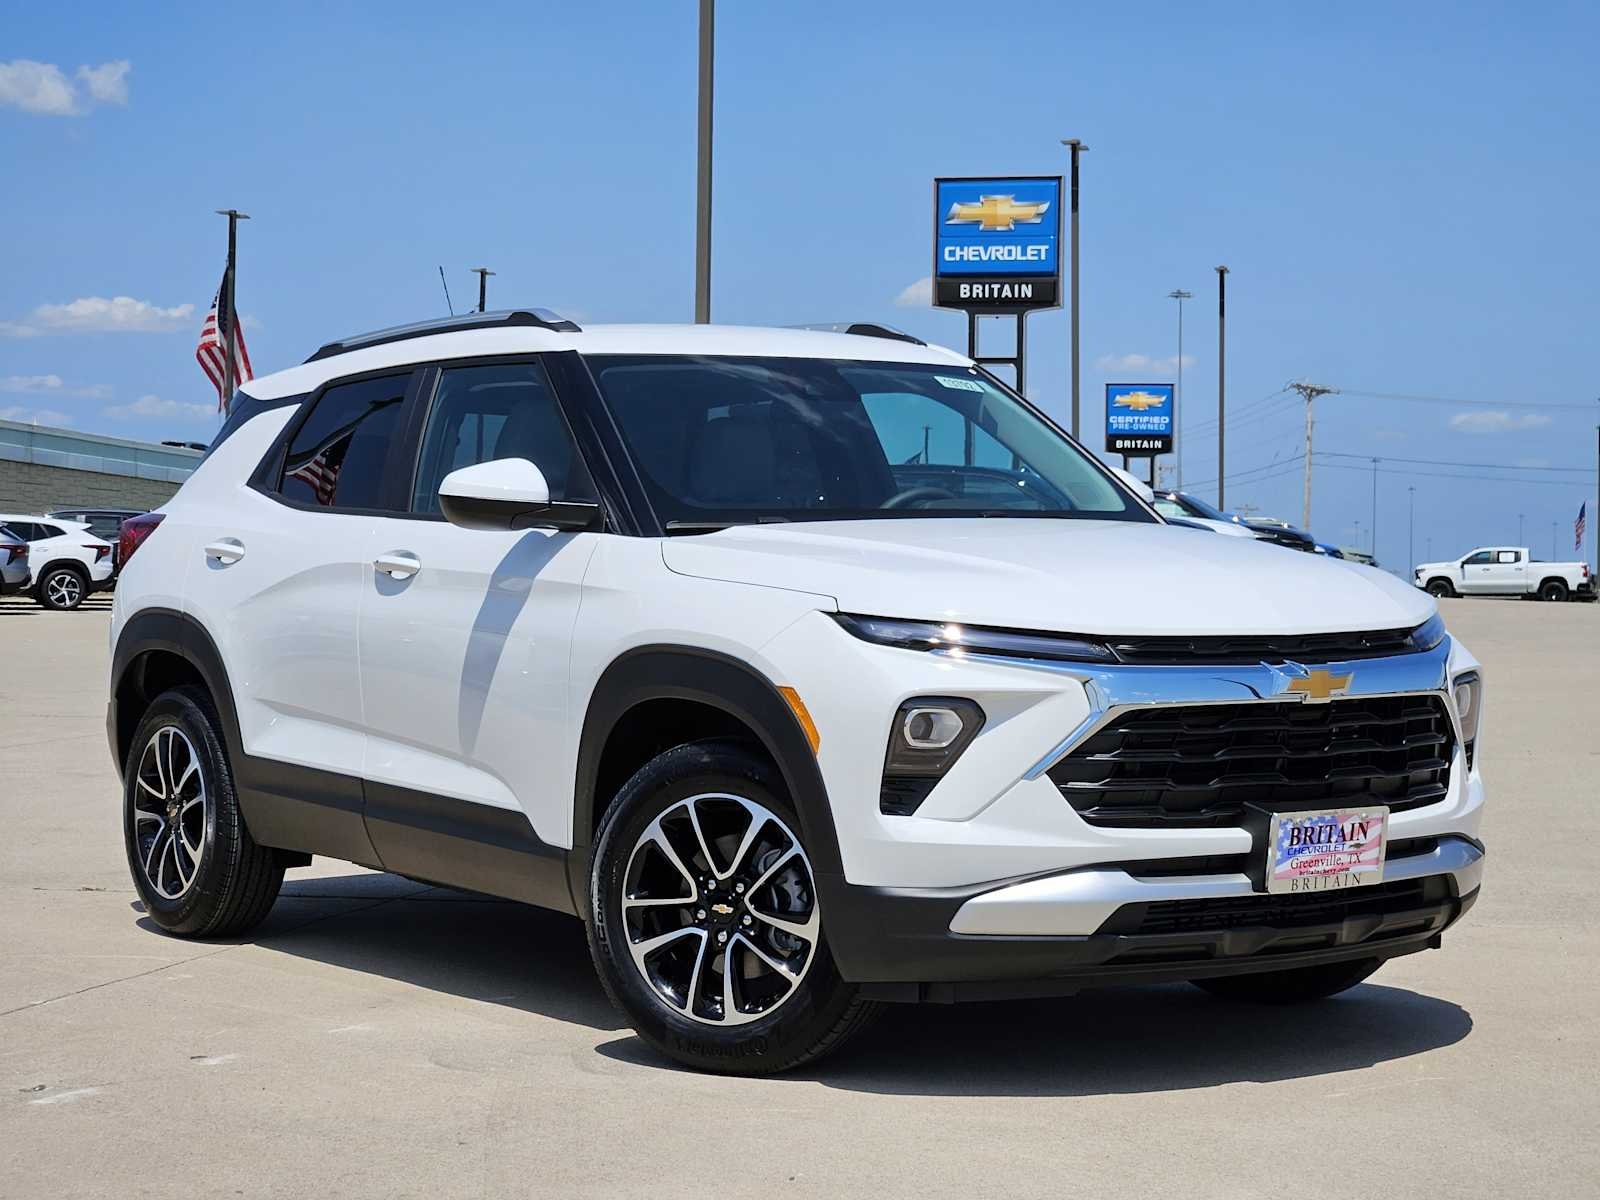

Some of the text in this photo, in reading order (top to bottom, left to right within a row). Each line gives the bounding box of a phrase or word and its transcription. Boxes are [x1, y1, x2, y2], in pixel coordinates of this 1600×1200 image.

[944, 245, 1049, 261] CHEVROLET
[959, 283, 1033, 299] BRITAIN
[1109, 416, 1169, 424] CERTIFIED
[1116, 440, 1162, 448] BRITAIN
[1290, 822, 1370, 845] BRITAIN
[1288, 844, 1346, 855] CHEVROLET
[1290, 852, 1361, 870] Greenville, TX
[1291, 873, 1361, 891] BRITAIN
